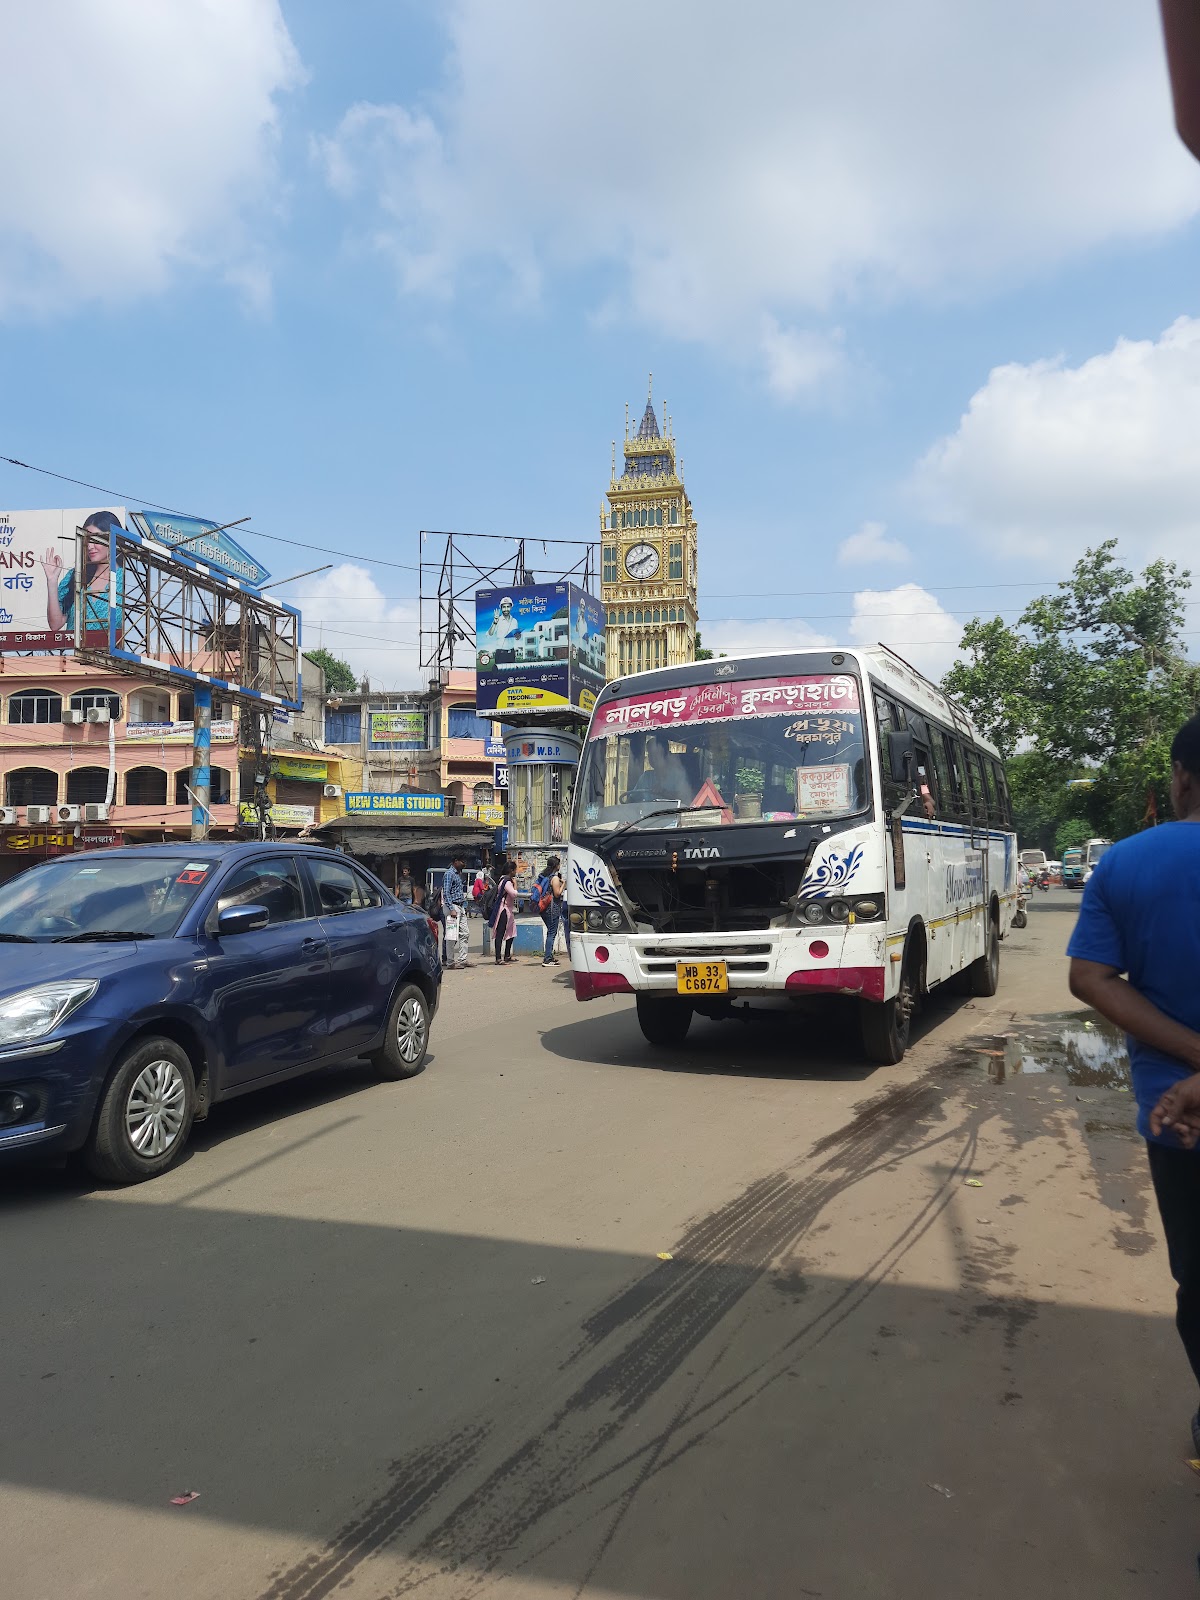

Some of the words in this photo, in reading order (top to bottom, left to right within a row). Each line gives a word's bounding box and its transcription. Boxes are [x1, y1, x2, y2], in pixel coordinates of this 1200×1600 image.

[3, 572, 34, 593] বড়ি
[605, 697, 687, 724] লালগড়
[690, 685, 738, 711] মেদিনীপুর
[537, 746, 561, 756] W.B.P.
[348, 796, 371, 809] NEW
[372, 796, 405, 809] SAGAR
[406, 797, 441, 810] STUDIO
[683, 847, 720, 859] TATA
[685, 966, 699, 977] WB
[706, 965, 719, 977] 33
[686, 978, 720, 990] C6874
